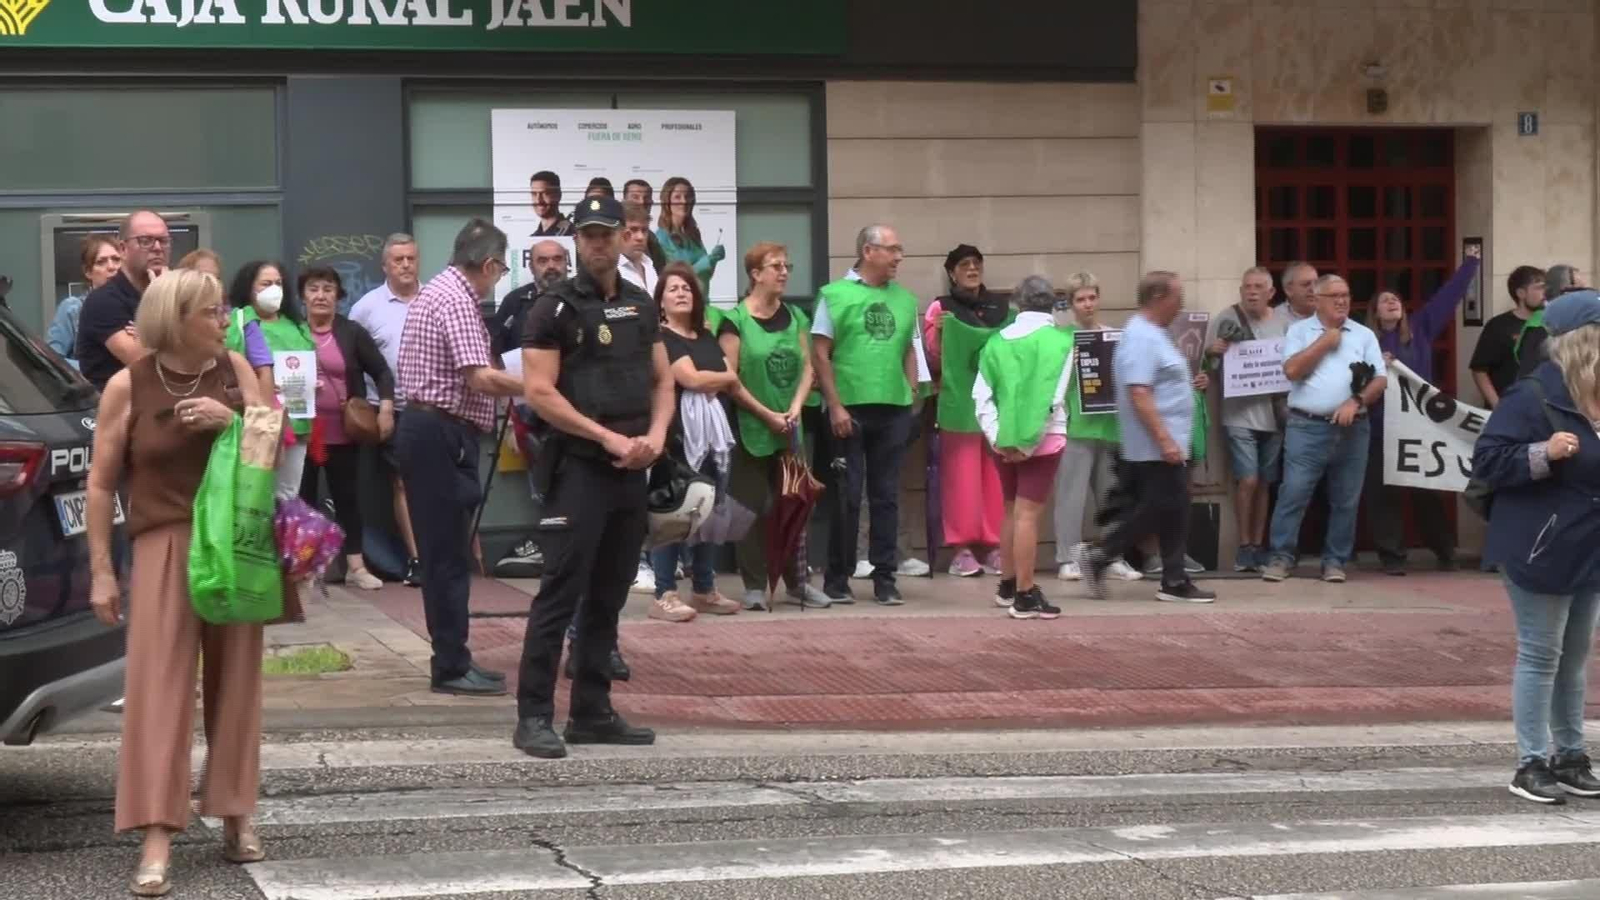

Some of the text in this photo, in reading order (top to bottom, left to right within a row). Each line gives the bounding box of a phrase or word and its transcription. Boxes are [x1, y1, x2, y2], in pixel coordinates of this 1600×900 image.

[261, 0, 473, 26] RURAL
[1523, 113, 1534, 134] 8
[867, 311, 893, 325] STOP
[1398, 375, 1458, 423] NO
